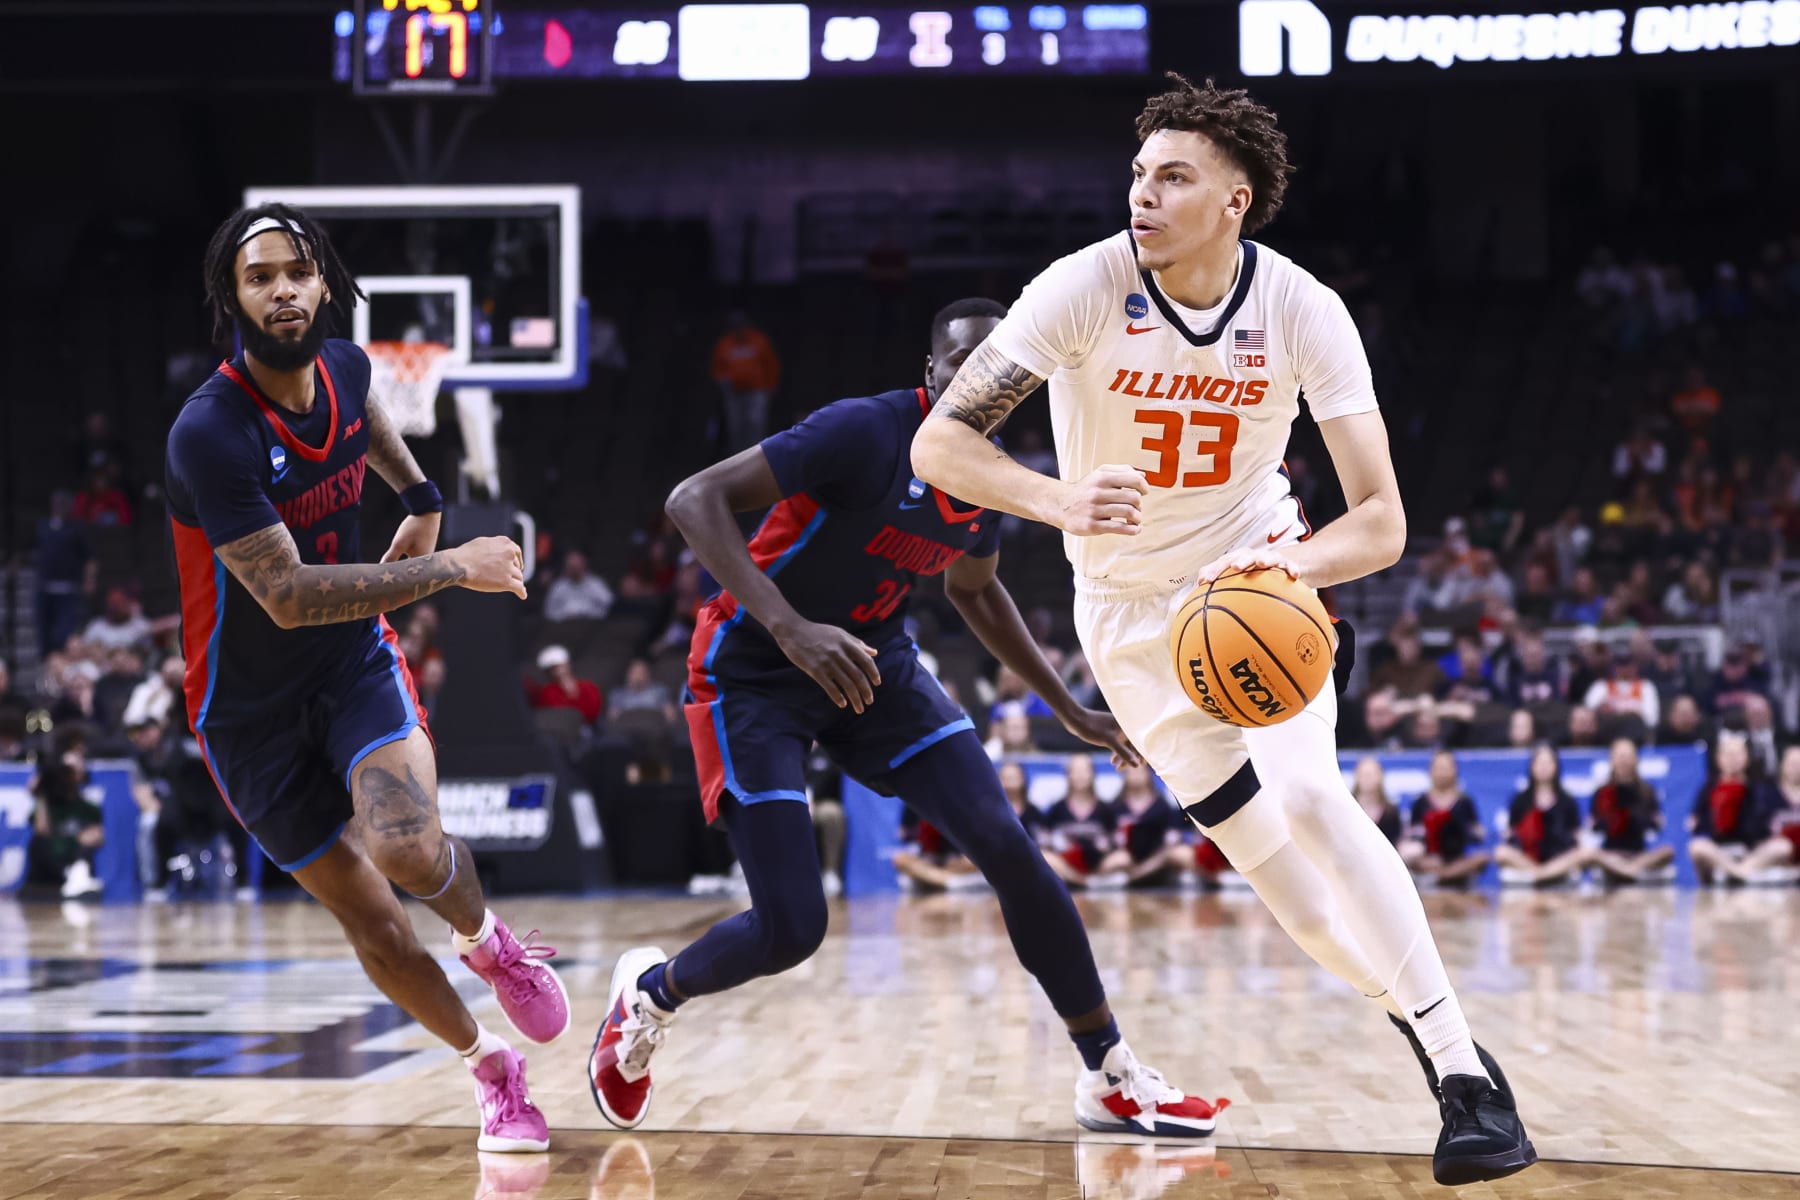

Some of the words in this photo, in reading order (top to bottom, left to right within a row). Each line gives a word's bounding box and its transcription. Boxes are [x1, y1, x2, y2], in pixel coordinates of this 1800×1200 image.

[1346, 9, 1626, 68] DUQUESNE
[1108, 368, 1269, 407] ILLINOIS
[1134, 409, 1240, 488] 33
[1229, 657, 1287, 718] NCAA
